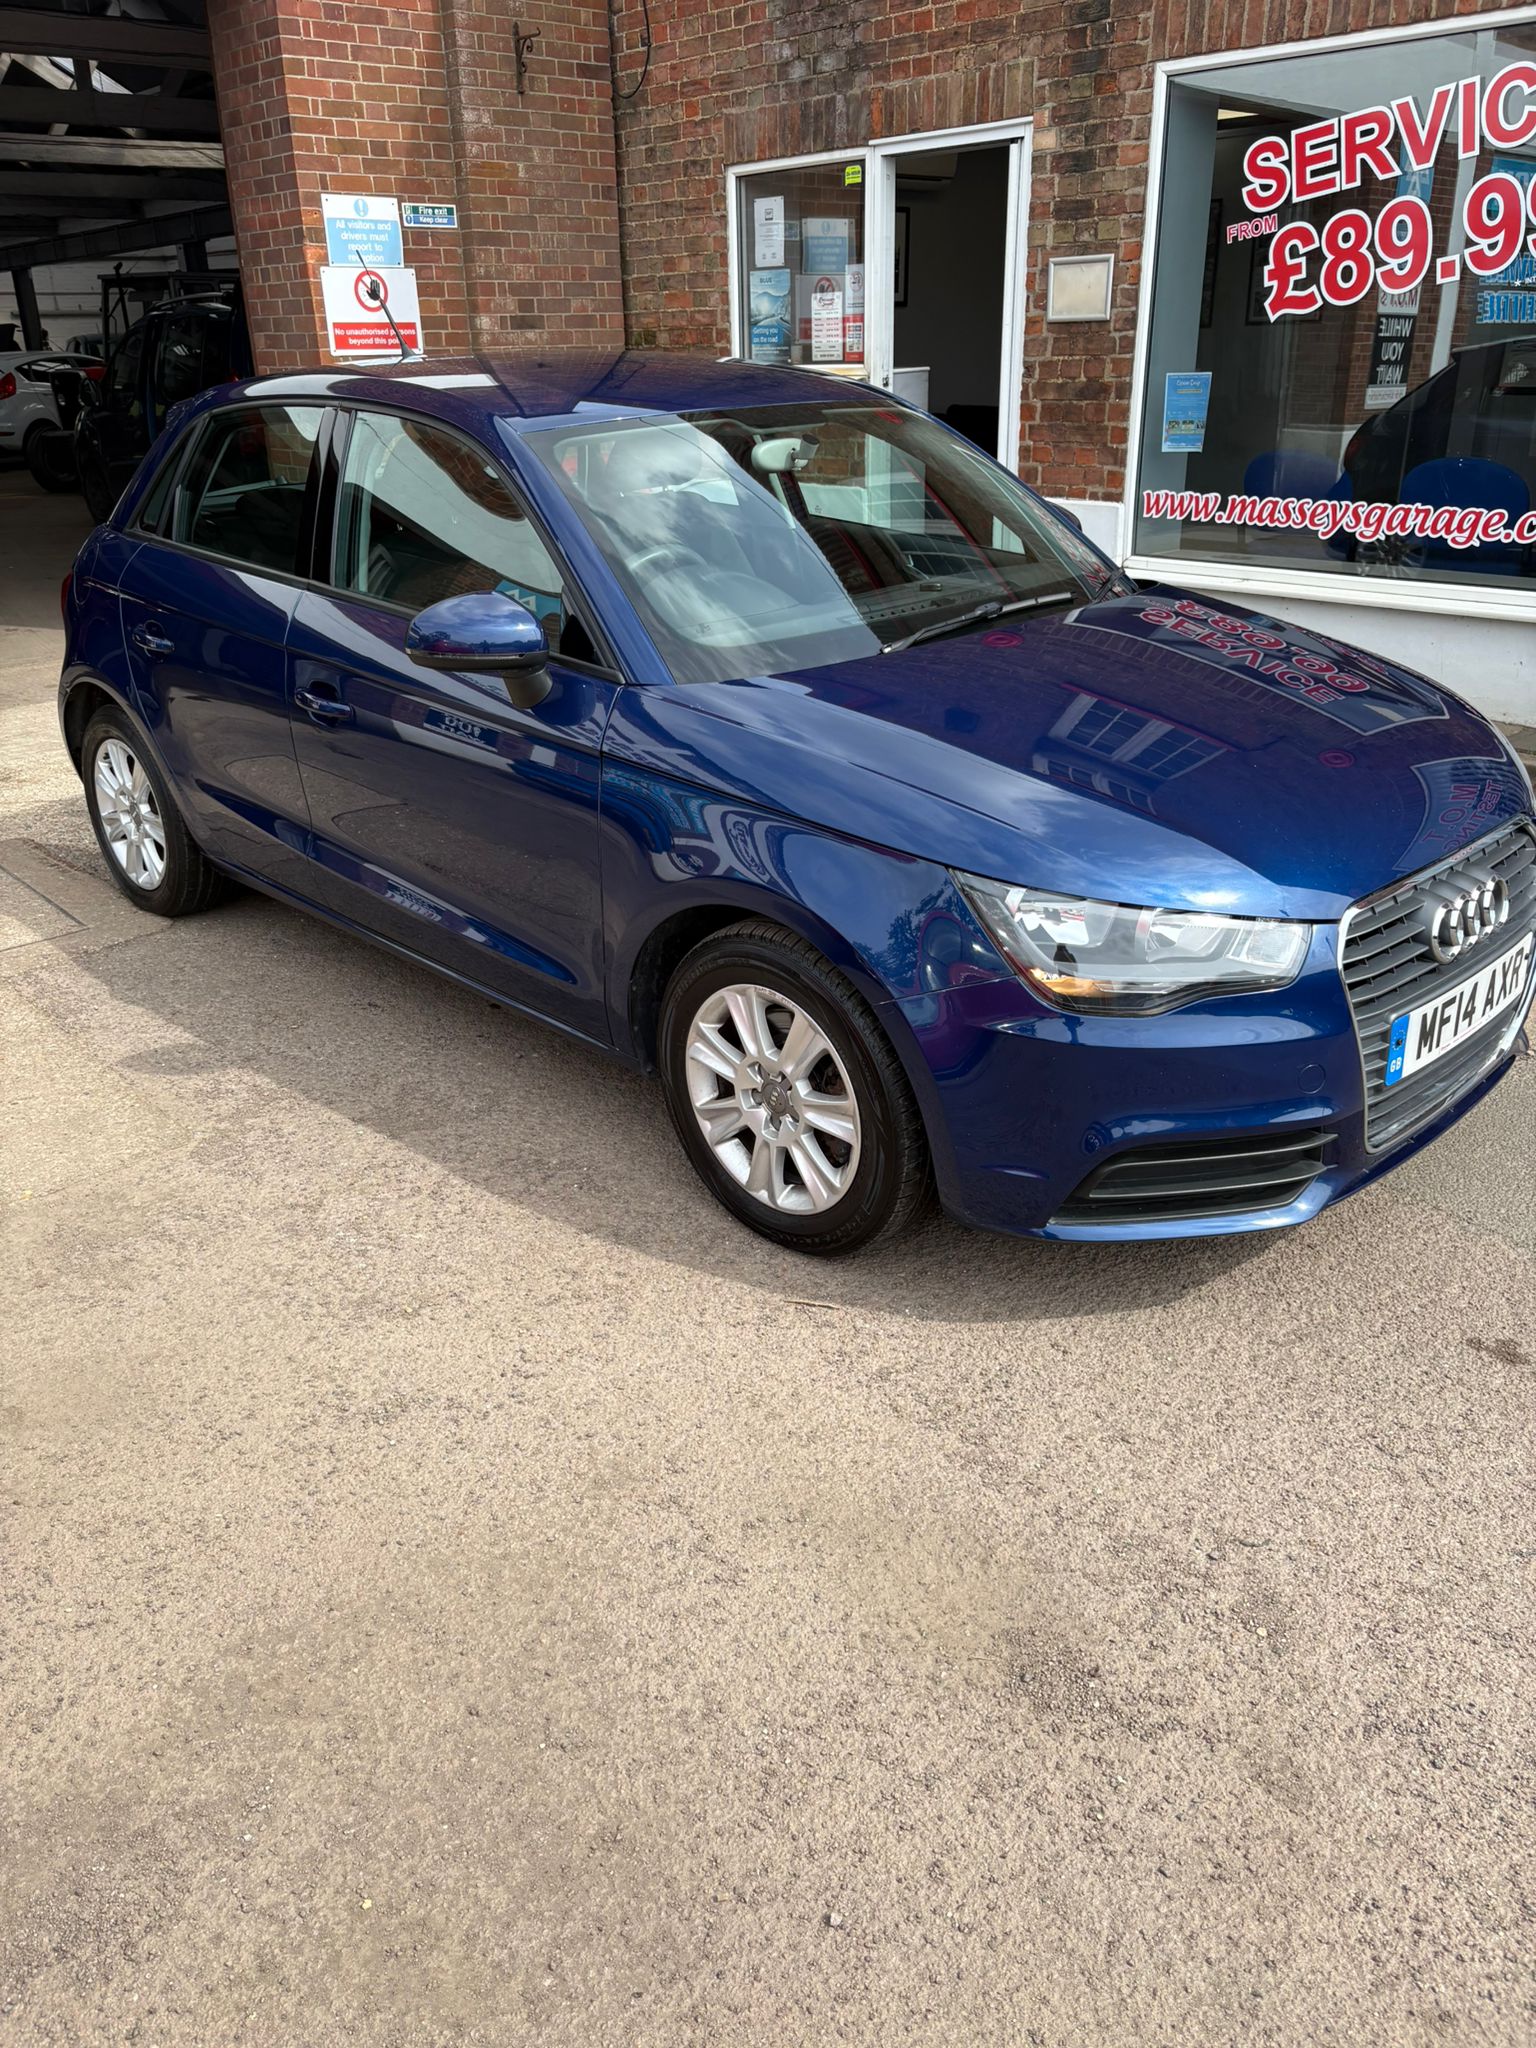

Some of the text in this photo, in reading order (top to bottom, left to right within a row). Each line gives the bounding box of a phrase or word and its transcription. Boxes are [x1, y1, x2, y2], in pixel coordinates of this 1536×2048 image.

[1242, 61, 1536, 213] SERVIC
[419, 206, 448, 216] Fire exit
[336, 219, 391, 231] All visitors and
[420, 216, 434, 225] Keep
[1226, 213, 1278, 244] FROM
[341, 231, 389, 242] drivers must
[348, 243, 384, 252] report to
[1263, 172, 1536, 323] £89.9
[346, 327, 389, 336] unauthorised
[349, 337, 374, 346] beyond
[1142, 489, 1536, 549] www.masseysgarage.c
[1416, 946, 1525, 1061] MF14 AXR
[1390, 1056, 1402, 1073] GB
